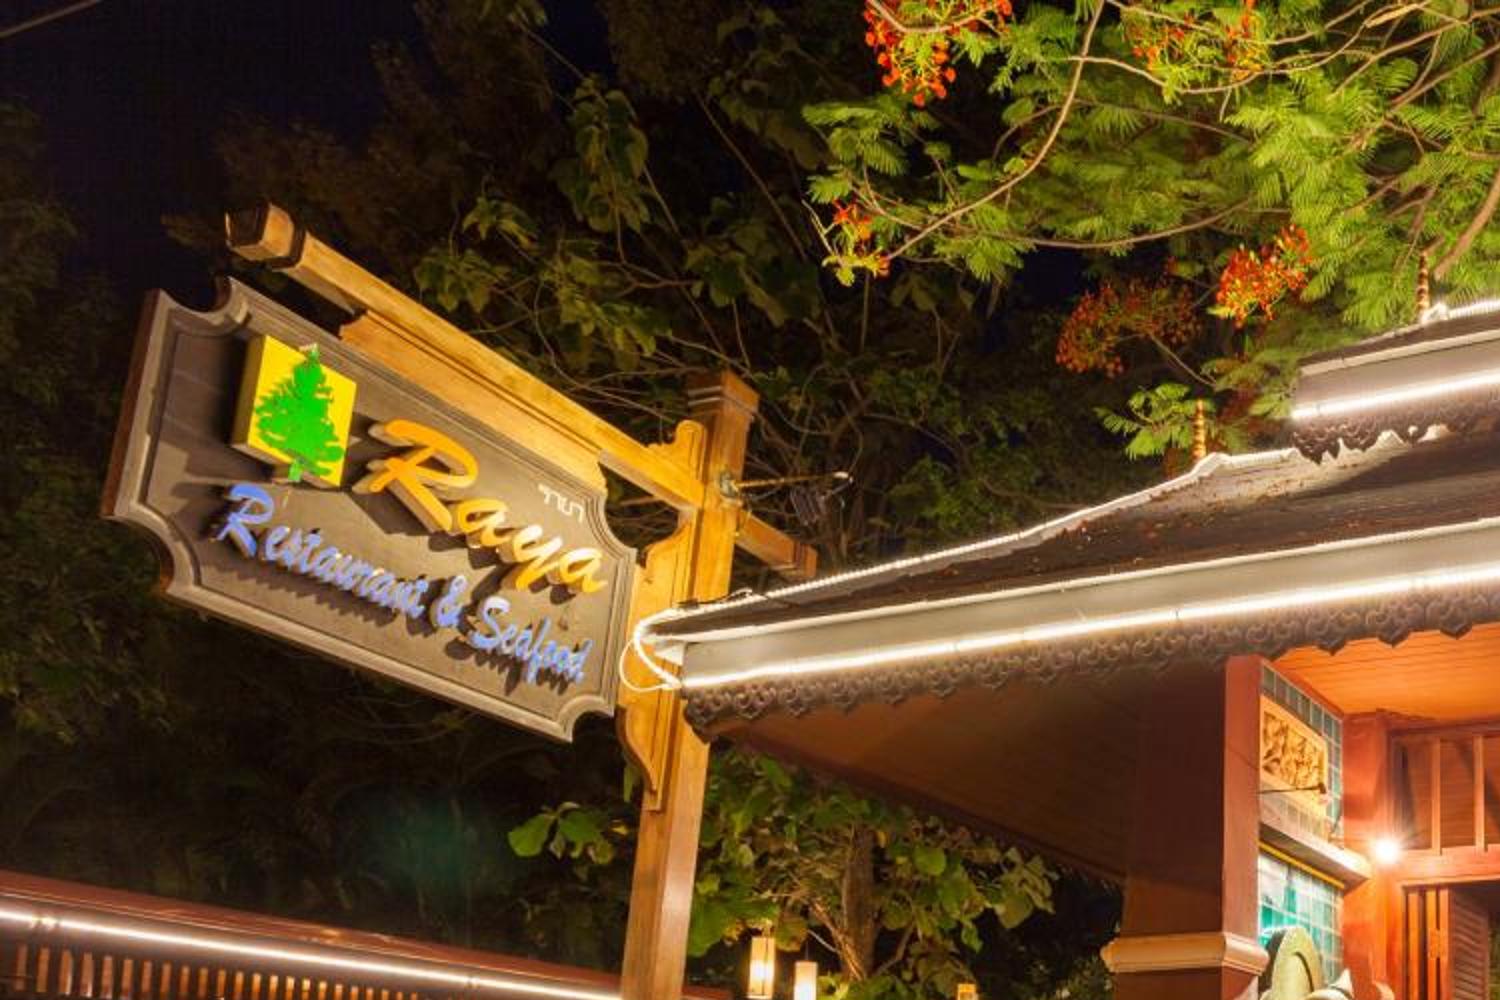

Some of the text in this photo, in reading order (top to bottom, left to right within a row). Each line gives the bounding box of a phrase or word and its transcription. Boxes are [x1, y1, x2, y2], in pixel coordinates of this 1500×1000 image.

[215, 483, 594, 684] Restaurant & Seafood
[364, 418, 607, 594] Raya
